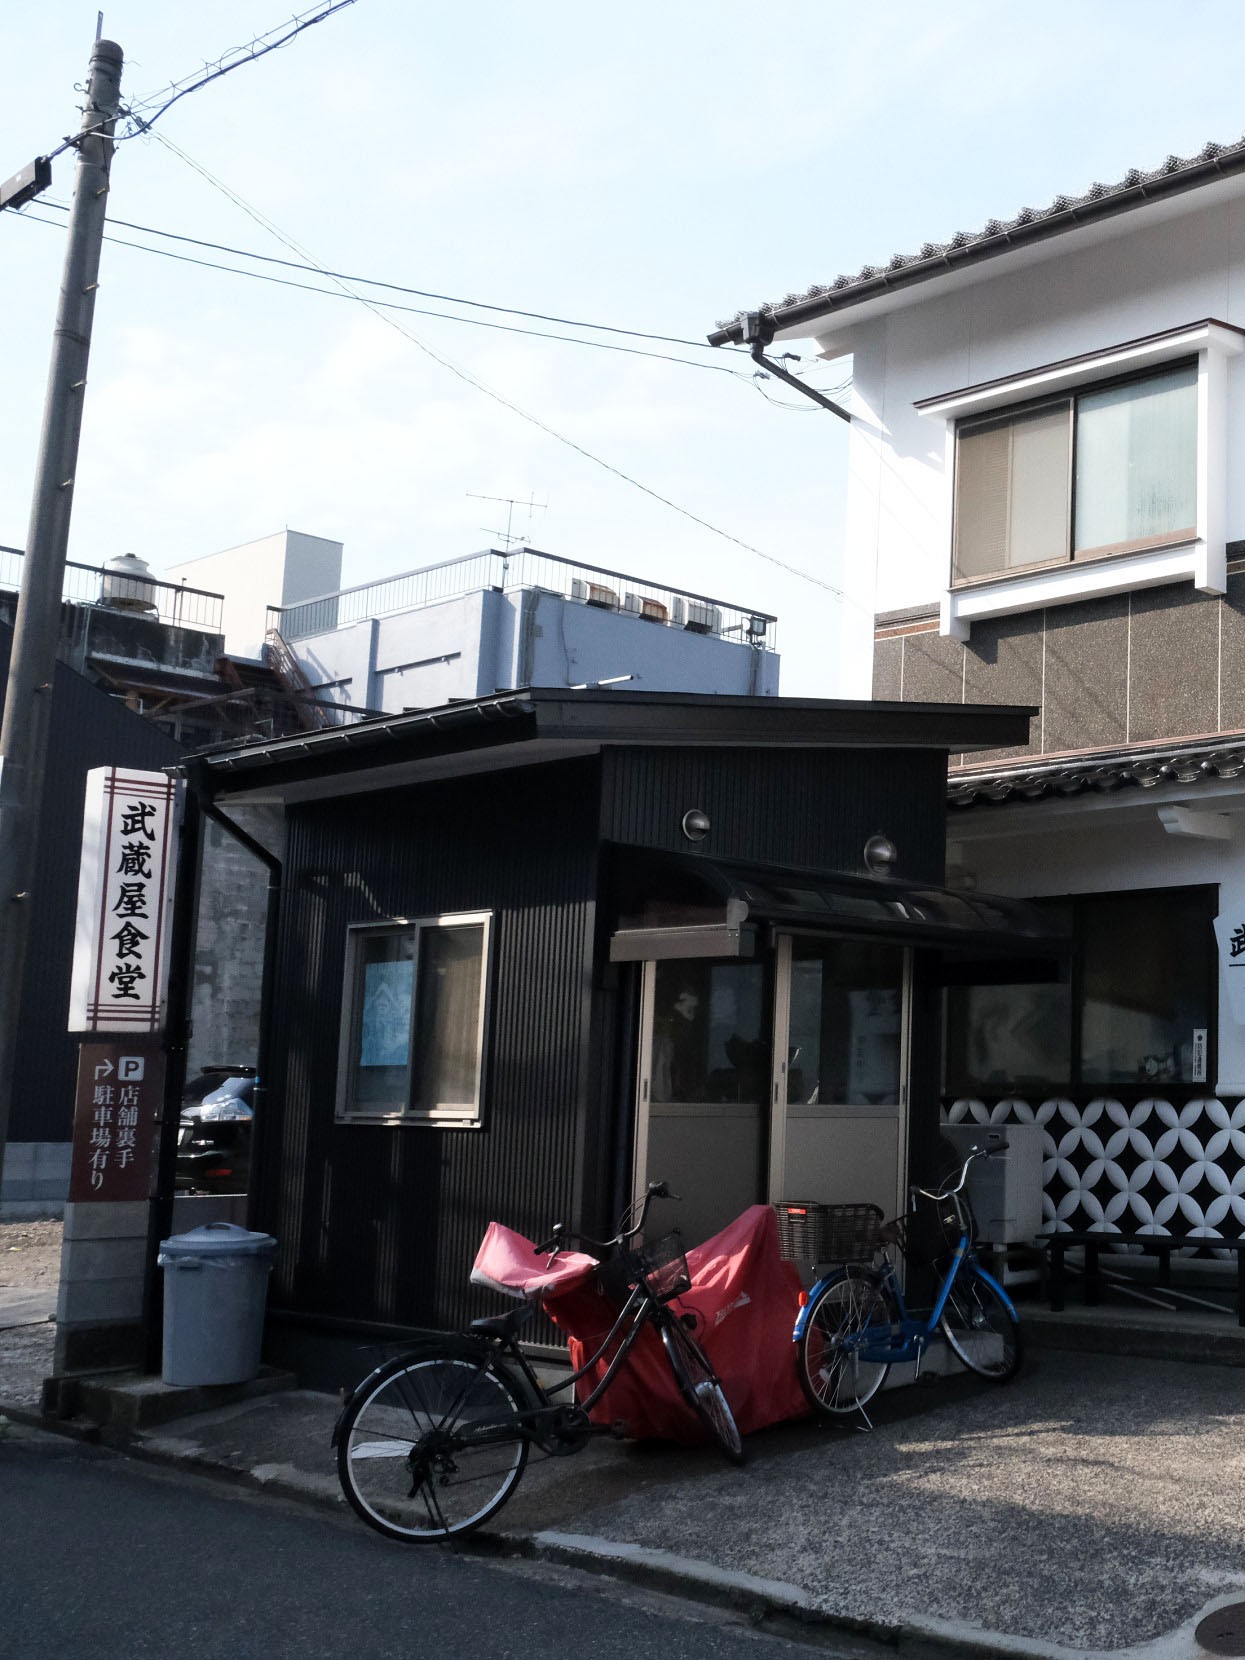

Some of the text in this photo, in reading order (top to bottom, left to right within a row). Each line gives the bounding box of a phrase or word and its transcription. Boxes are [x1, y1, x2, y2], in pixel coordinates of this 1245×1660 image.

[108, 801, 156, 1000] 武蔵屋食堂
[88, 1085, 115, 1192] 駐車場有り
[113, 1085, 140, 1169] 店舗裏手
